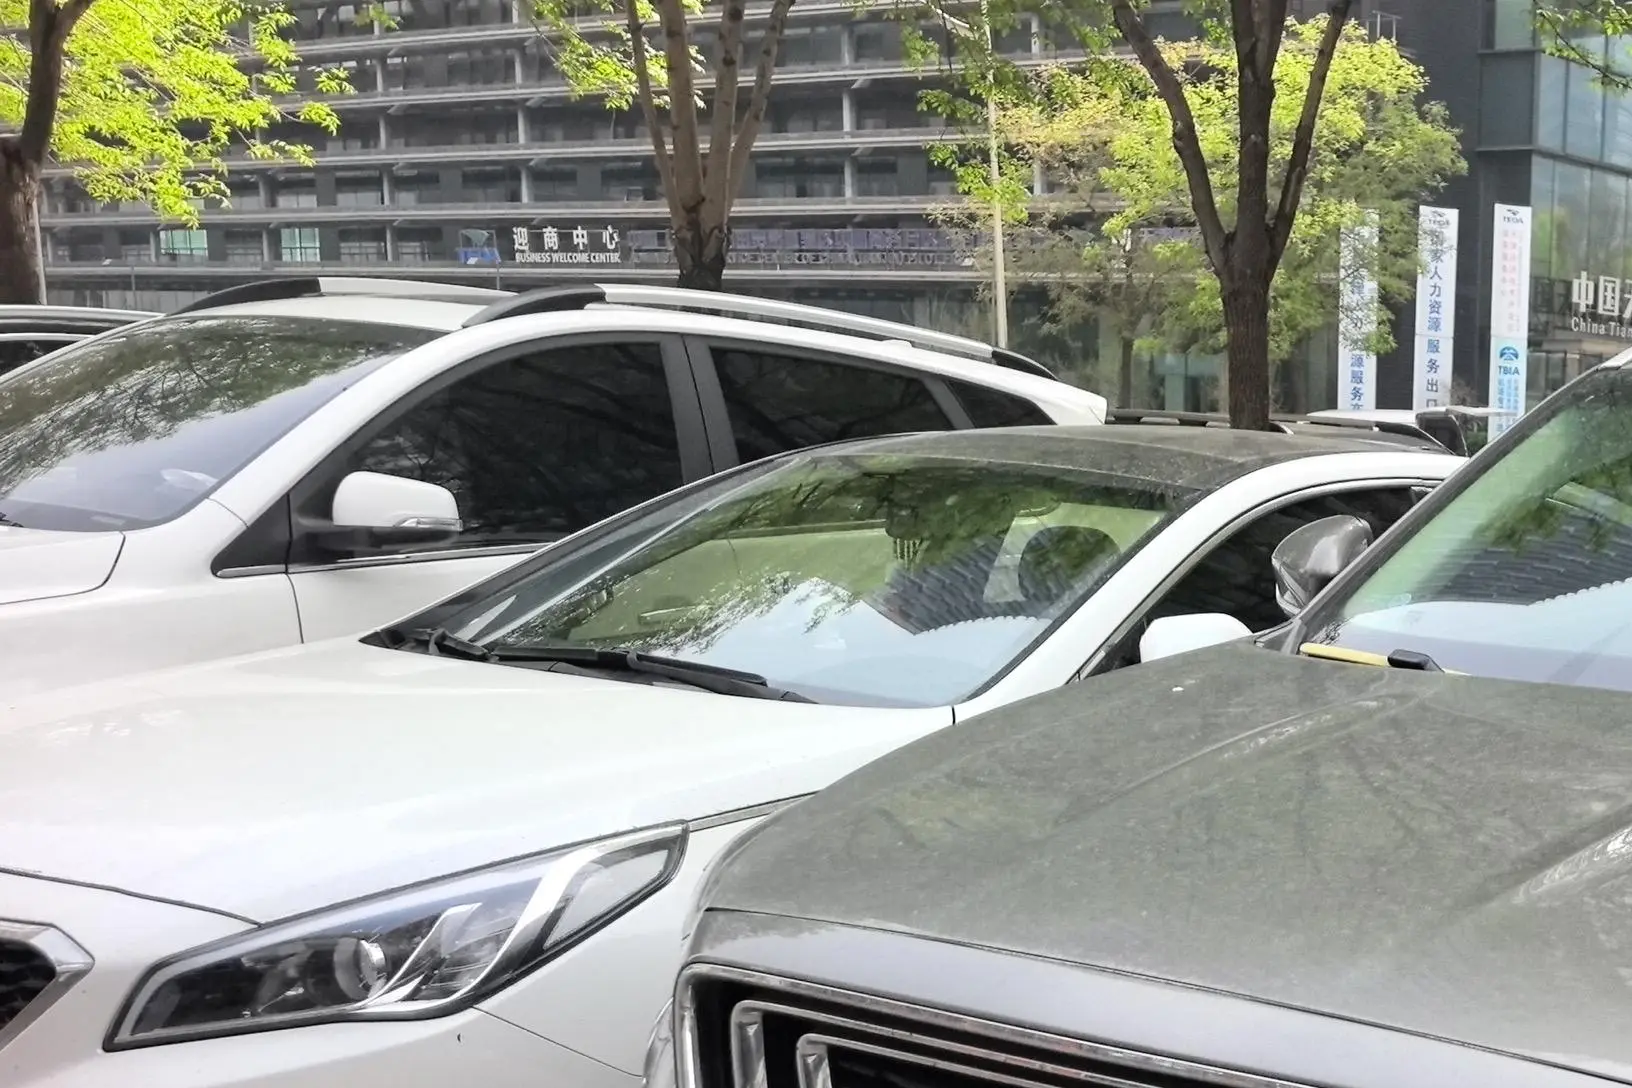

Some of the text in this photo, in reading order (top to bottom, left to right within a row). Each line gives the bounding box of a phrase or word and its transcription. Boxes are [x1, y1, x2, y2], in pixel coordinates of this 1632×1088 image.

[513, 225, 620, 250] 迎商中心
[515, 252, 551, 263] BUSINESS
[552, 252, 590, 263] WELCOME
[591, 252, 621, 263] CENTER
[1572, 317, 1605, 335] China
